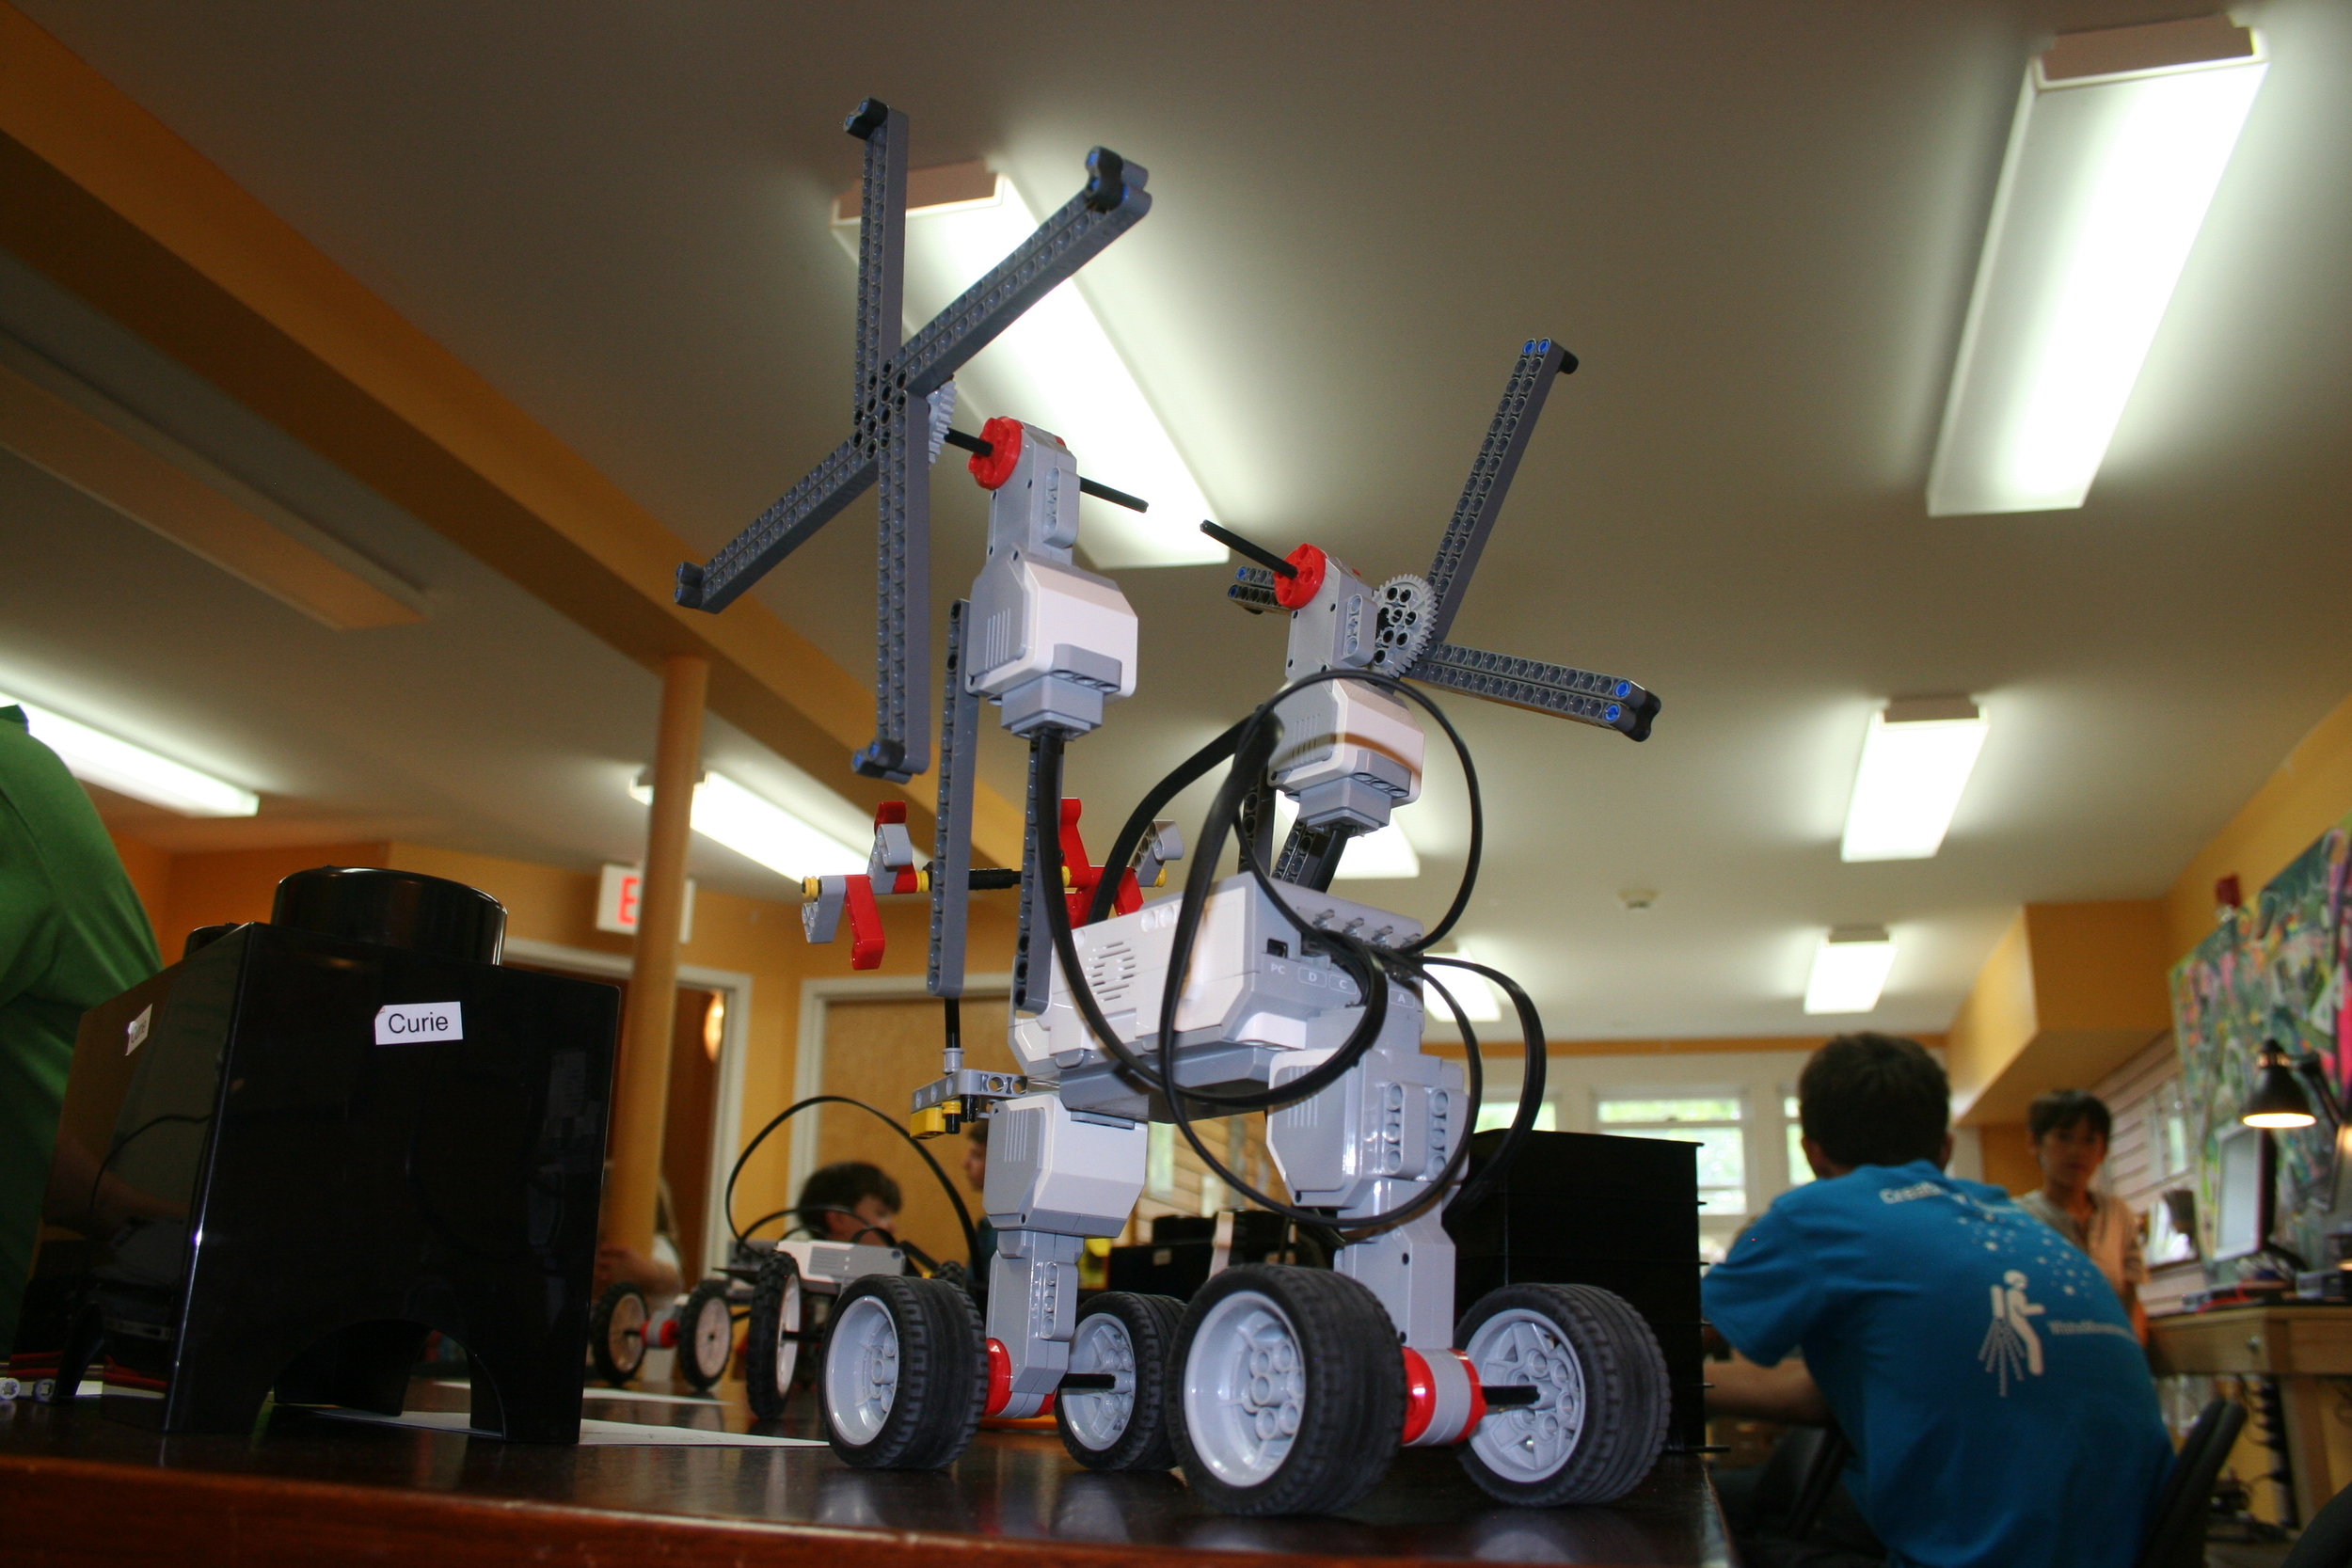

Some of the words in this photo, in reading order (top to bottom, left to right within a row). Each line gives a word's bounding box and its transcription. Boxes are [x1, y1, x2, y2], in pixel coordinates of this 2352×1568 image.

[1271, 963, 1285, 974] PC
[1309, 972, 1317, 982] D
[1339, 979, 1347, 990] C
[1398, 993, 1406, 1004] A
[389, 1011, 449, 1034] Curie
